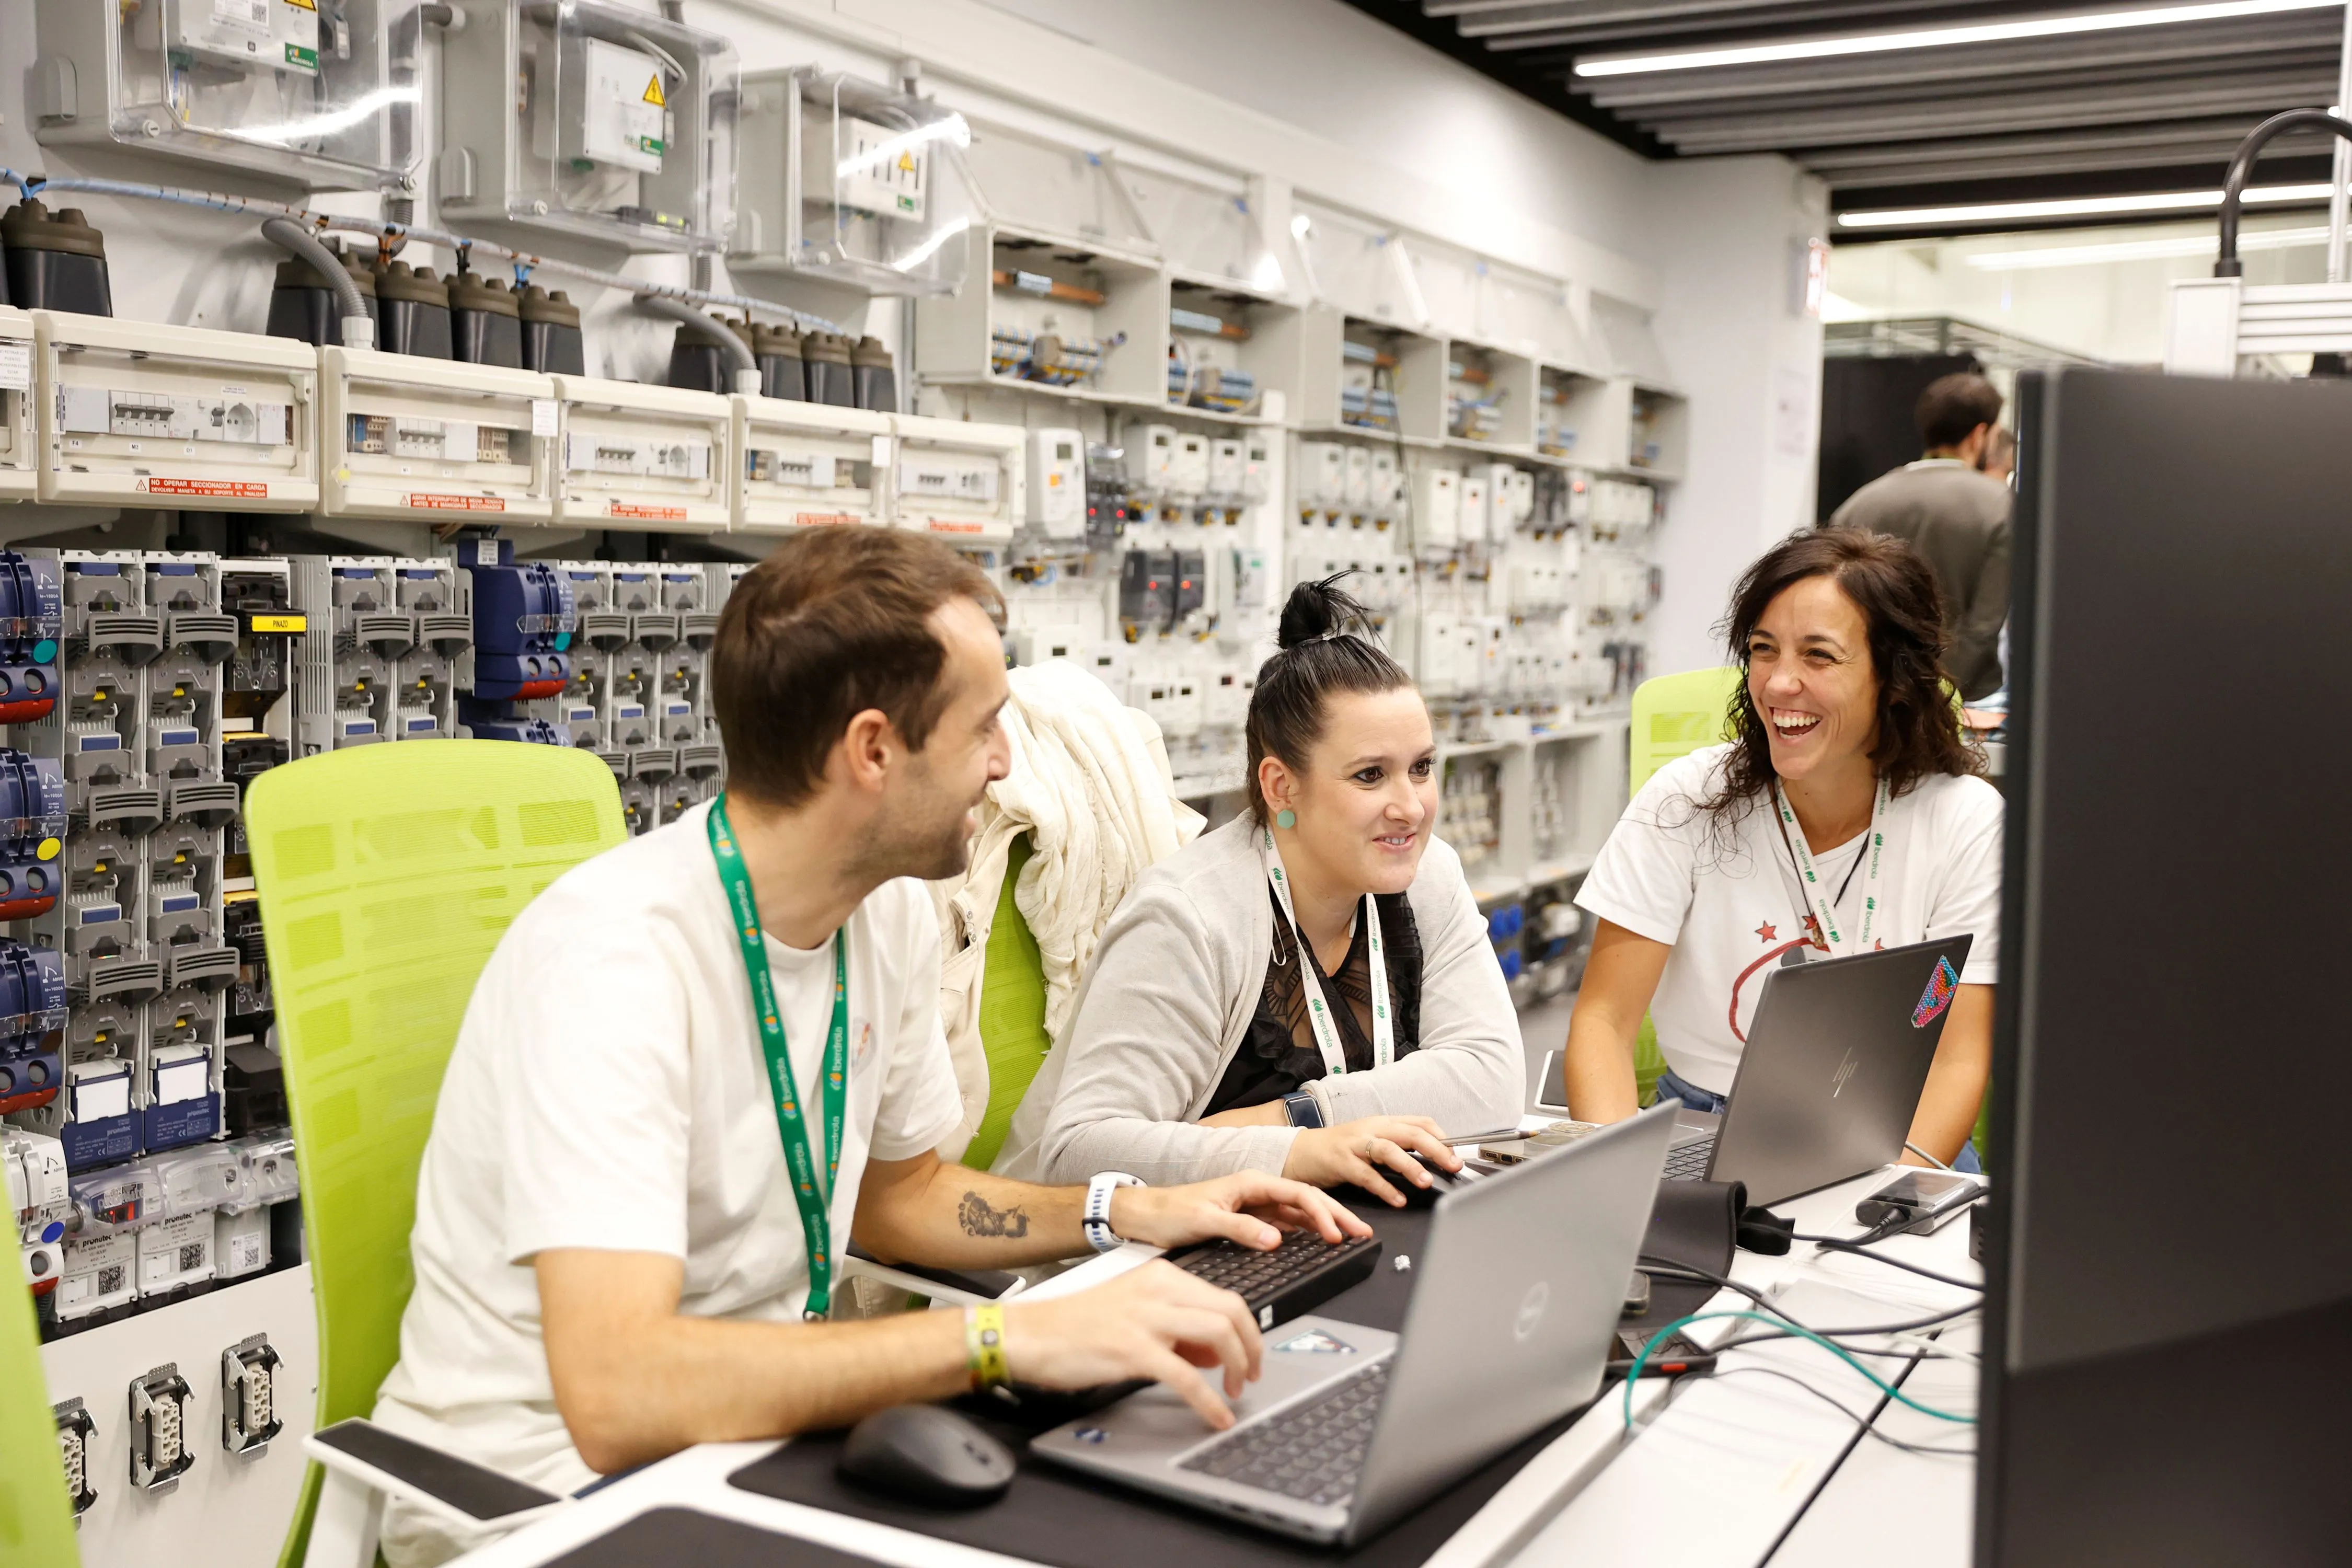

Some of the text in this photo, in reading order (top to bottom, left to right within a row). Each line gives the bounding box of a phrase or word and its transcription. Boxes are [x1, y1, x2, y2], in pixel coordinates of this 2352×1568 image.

[191, 481, 231, 489] SECCIONADOR
[1796, 839, 1811, 870] Iberdrola
[1871, 847, 1881, 879] Iberdrola
[1819, 899, 1835, 930] Iberdrola
[1862, 911, 1873, 943] Iberdrola
[1317, 1012, 1333, 1047] Iberdrola
[832, 1027, 843, 1071] Iberdrola
[165, 1213, 192, 1226] pronutec
[83, 1235, 112, 1248] pronutec
